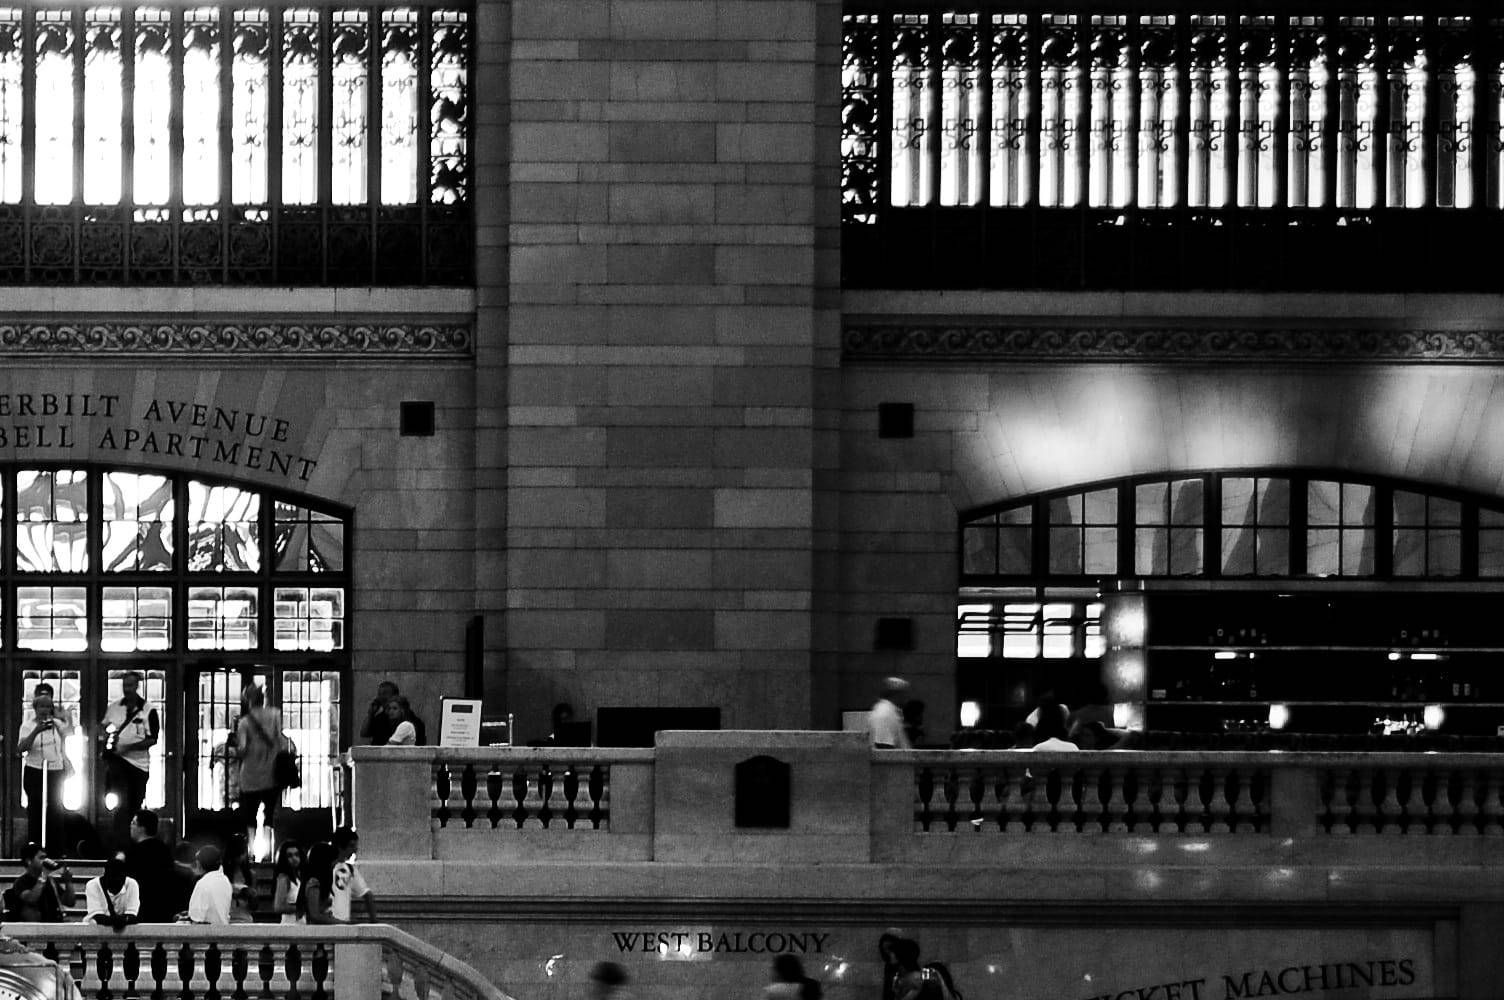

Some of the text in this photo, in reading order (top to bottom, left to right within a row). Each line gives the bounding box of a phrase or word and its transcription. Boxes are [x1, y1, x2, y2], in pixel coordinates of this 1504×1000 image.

[143, 399, 290, 443] AVENUE
[98, 427, 318, 481] APARTMENT
[612, 932, 830, 953] WEST BALCONY
[1223, 959, 1416, 1000] MACHINES
